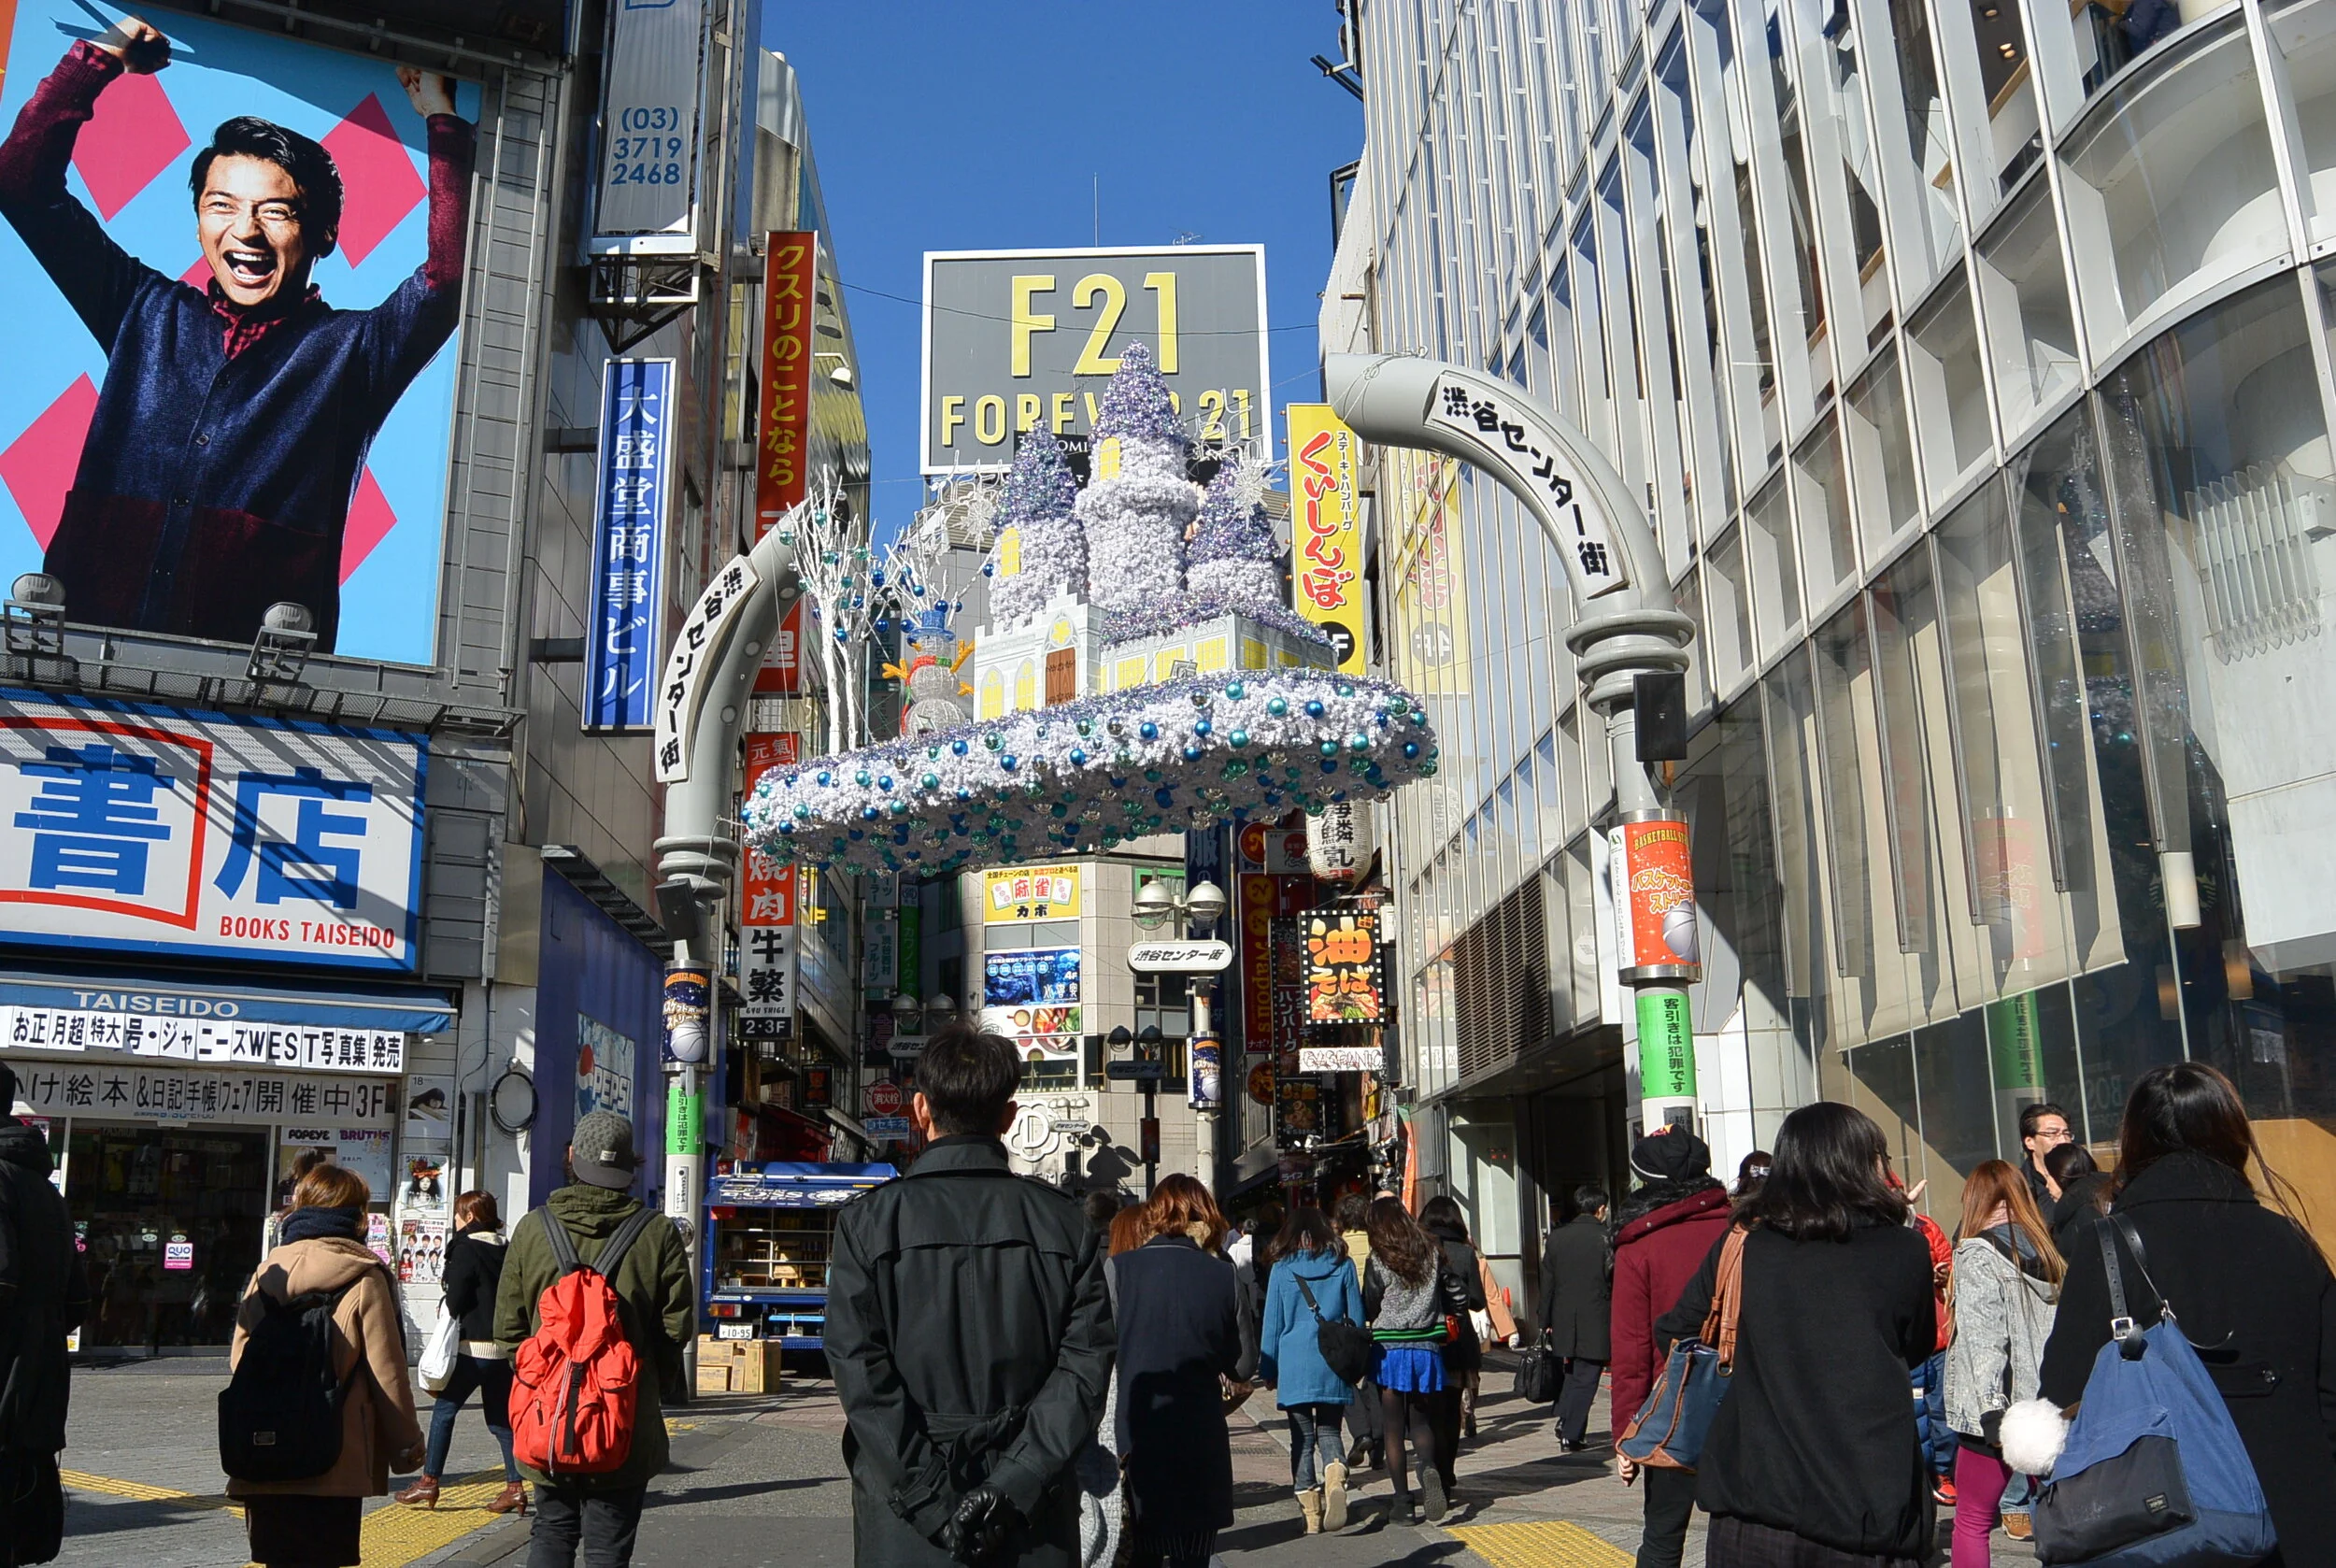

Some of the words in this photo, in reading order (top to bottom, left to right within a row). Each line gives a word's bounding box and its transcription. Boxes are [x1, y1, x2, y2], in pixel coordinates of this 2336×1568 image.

[621, 107, 679, 131] (03)
[613, 137, 682, 160] 3719
[610, 163, 680, 185] 2468
[1010, 271, 1179, 378] F21
[766, 245, 805, 486] クスリのことなら
[1199, 388, 1252, 440] 21
[1337, 431, 1353, 531] ステーキ&ハンバーグ
[1443, 386, 1611, 577] 渋谷センター街
[1300, 431, 1353, 609] くいしんぼ
[603, 386, 660, 701] 大盛堂商事ビル
[661, 565, 744, 774] 渋谷センター街
[13, 743, 374, 910] 書店
[1633, 829, 1678, 851] BASKETBALL
[1015, 877, 1050, 899] 麻雀
[1017, 904, 1047, 918] カボ
[219, 915, 290, 942] BOOKS
[301, 919, 396, 949] TAISEIDO
[1308, 916, 1372, 966] 油
[748, 929, 785, 1004] 牛繁
[869, 943, 879, 981] フルーツ
[1133, 948, 1226, 962] 渋谷センター街
[1310, 965, 1374, 994] そば
[73, 991, 239, 1018] TAISEIDO
[1278, 991, 1297, 1052] ハンバーグ
[890, 1041, 925, 1051] 渋谷セン
[1663, 998, 1687, 1093] 客引きは犯罪です
[592, 1065, 632, 1113] PEPSI
[874, 1093, 900, 1105] 消火栓
[288, 1130, 330, 1140] POPEYE
[339, 1130, 392, 1141] BRUTUS
[168, 1246, 191, 1257] QUO
